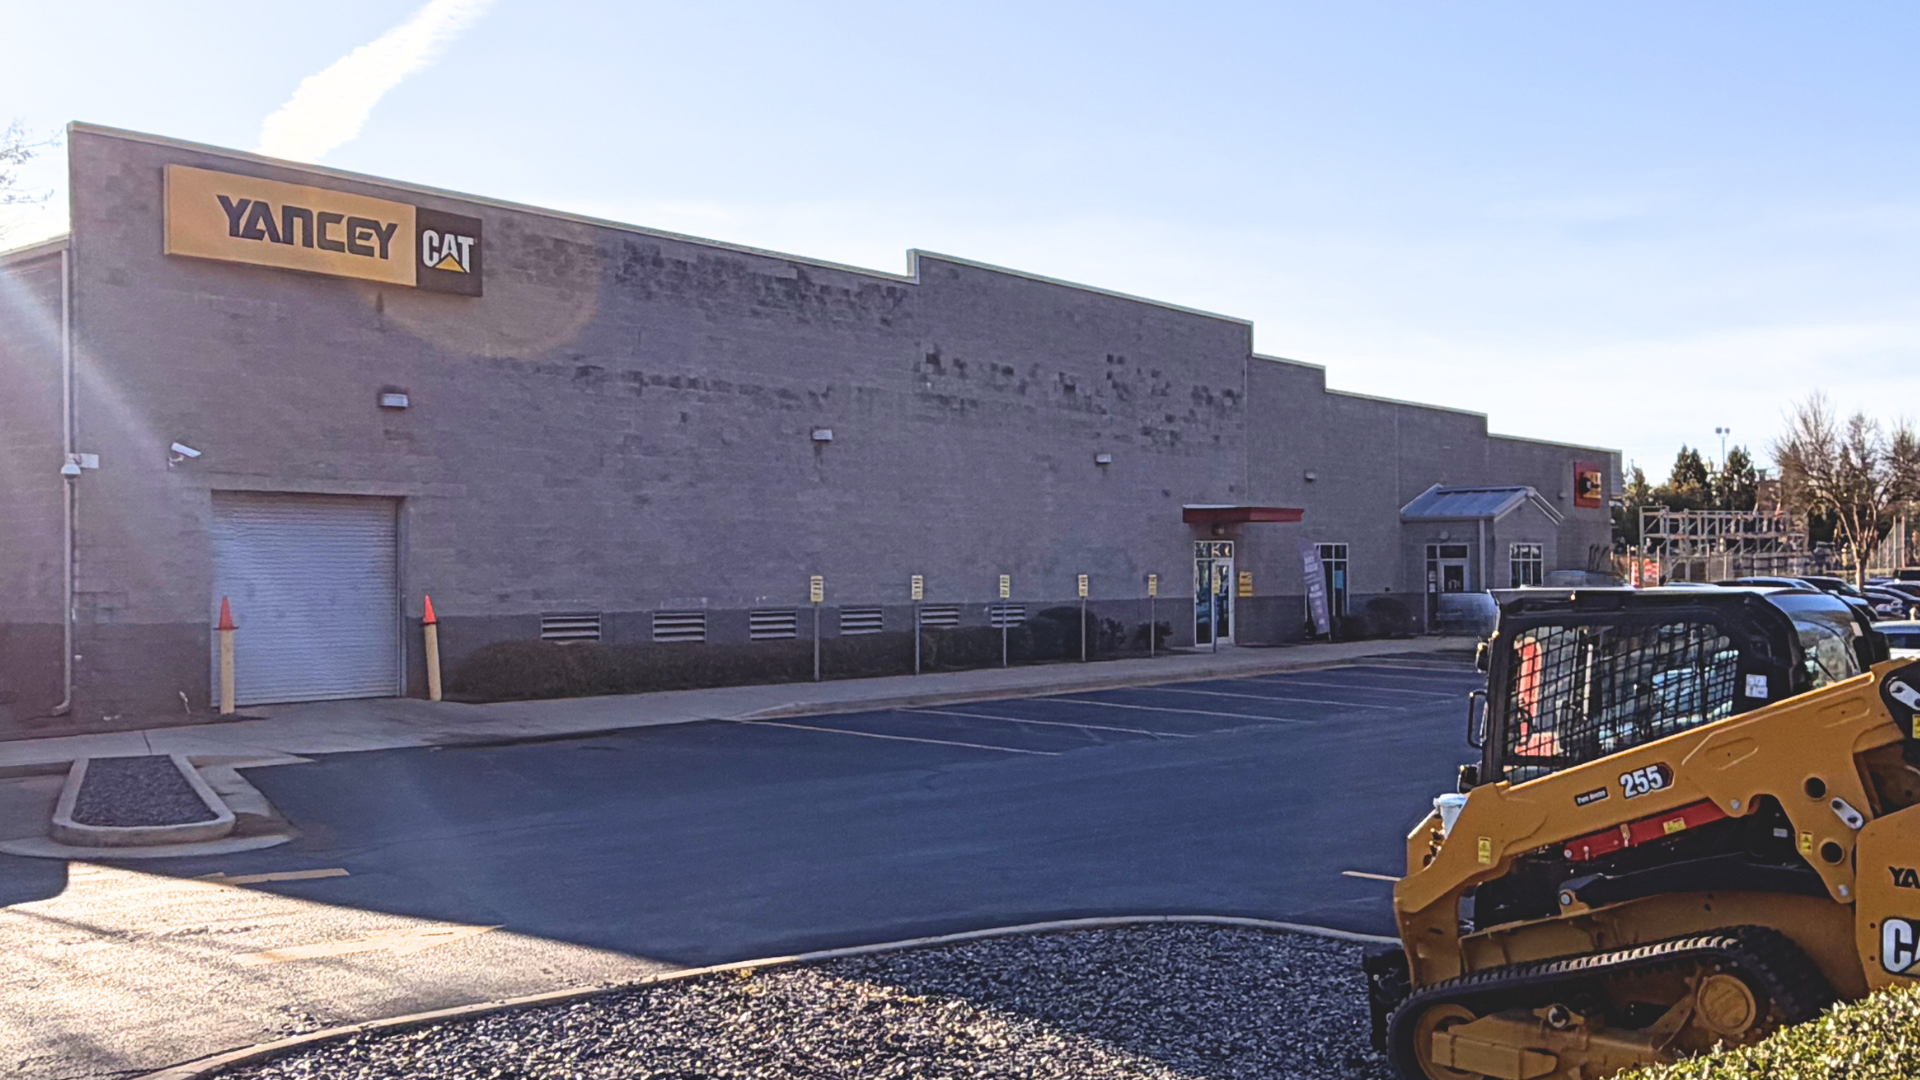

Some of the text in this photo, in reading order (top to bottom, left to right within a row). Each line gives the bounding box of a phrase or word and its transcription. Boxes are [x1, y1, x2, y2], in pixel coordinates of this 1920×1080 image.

[216, 194, 475, 273] YANCEY CAT
[1620, 765, 1663, 798] 255
[1882, 918, 1920, 973] C
